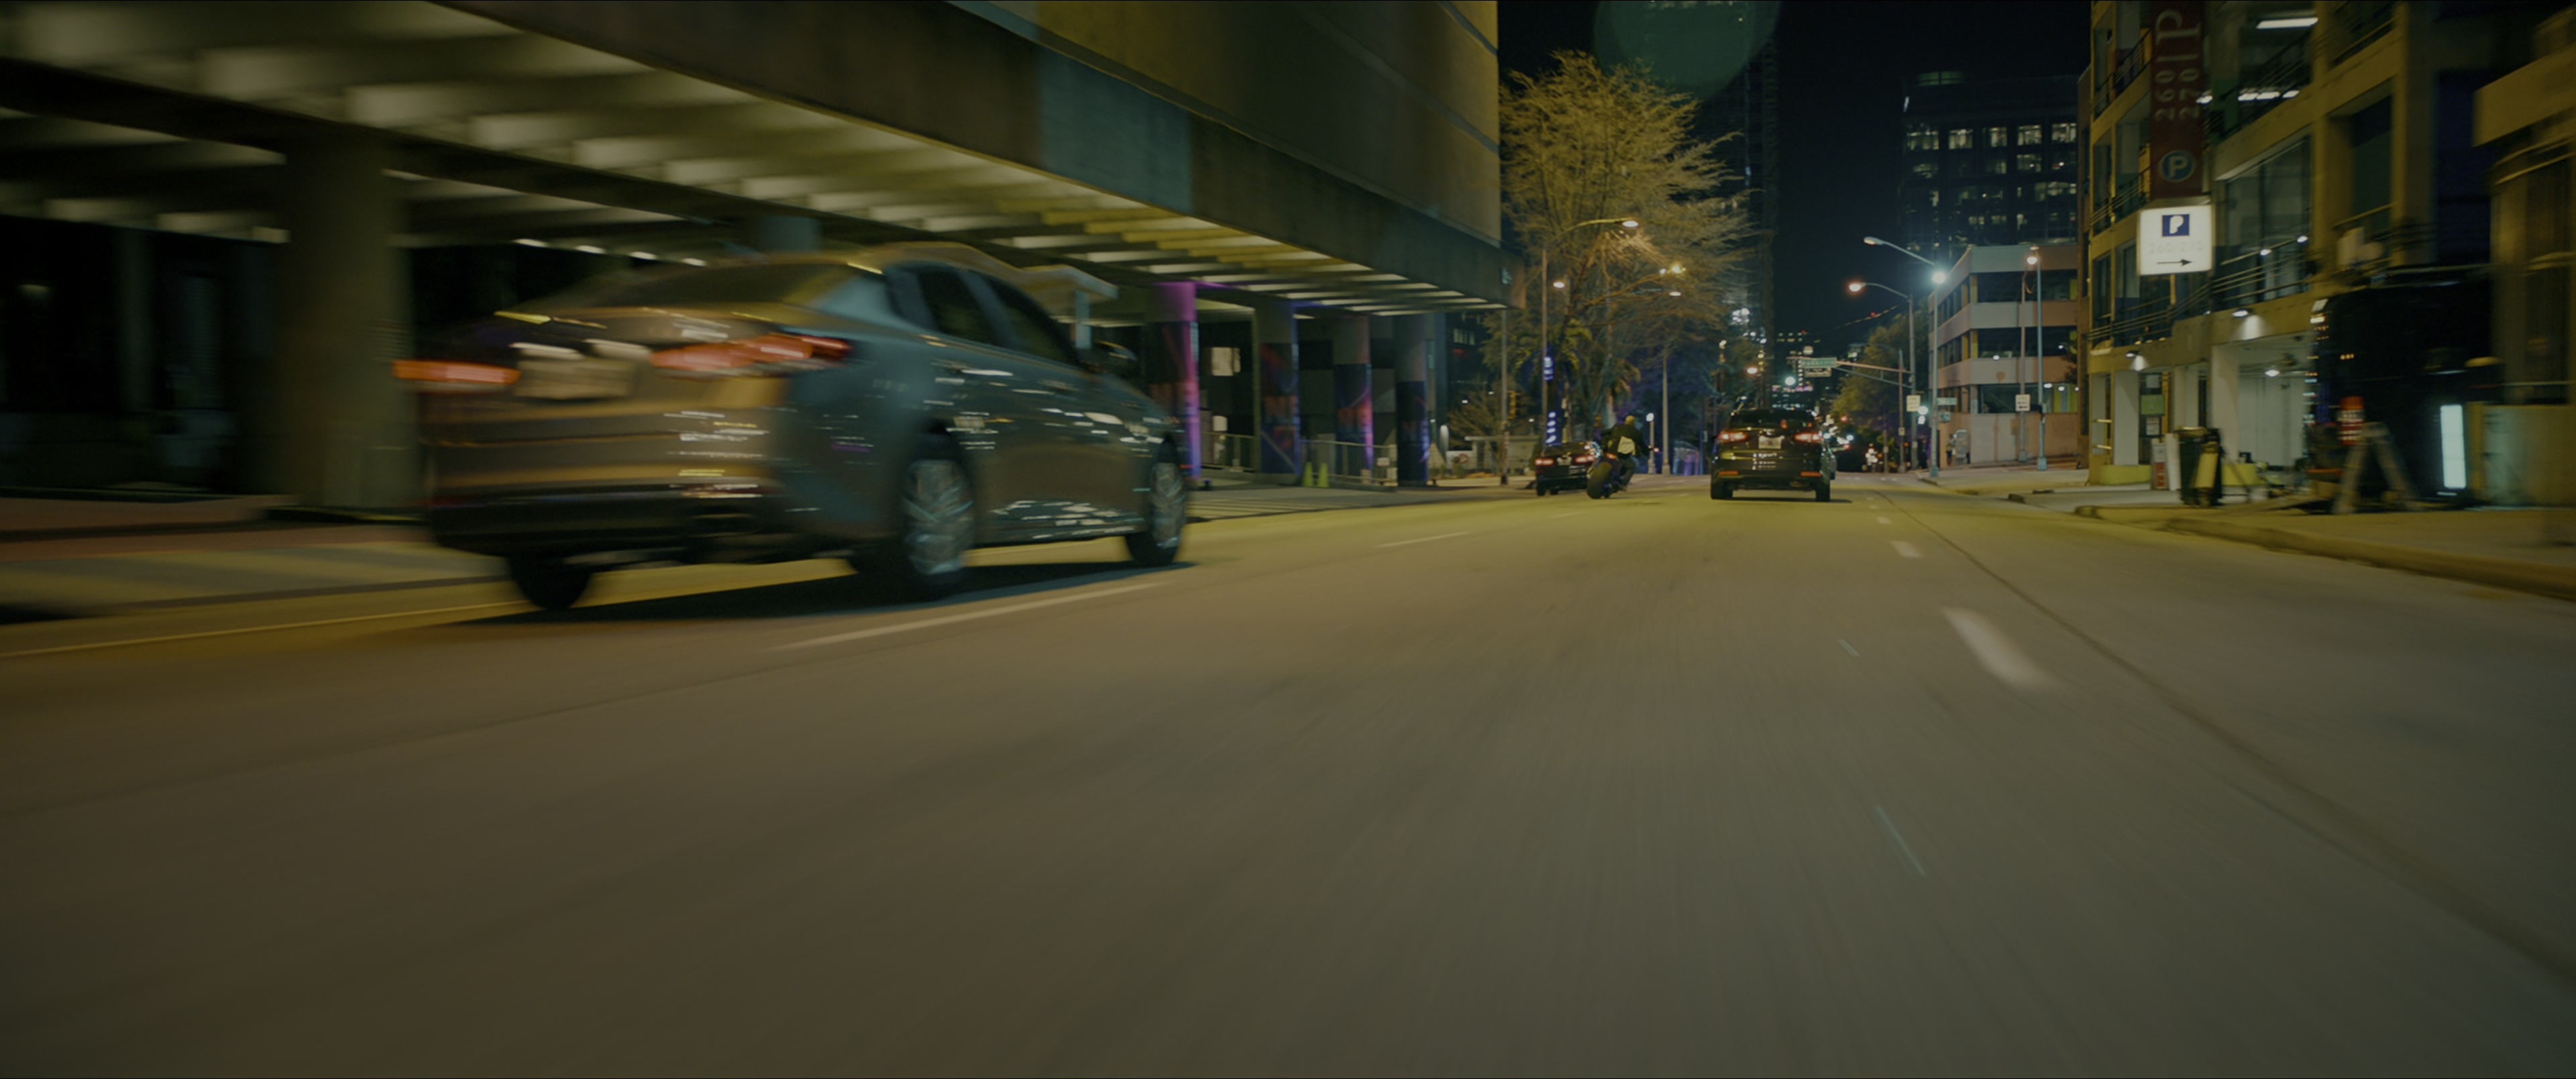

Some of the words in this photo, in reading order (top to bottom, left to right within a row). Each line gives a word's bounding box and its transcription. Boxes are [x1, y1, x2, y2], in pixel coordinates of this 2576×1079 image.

[2154, 69, 2176, 122] 260
[2178, 68, 2200, 120] 270
[2168, 155, 2189, 179] P
[2169, 215, 2184, 234] P
